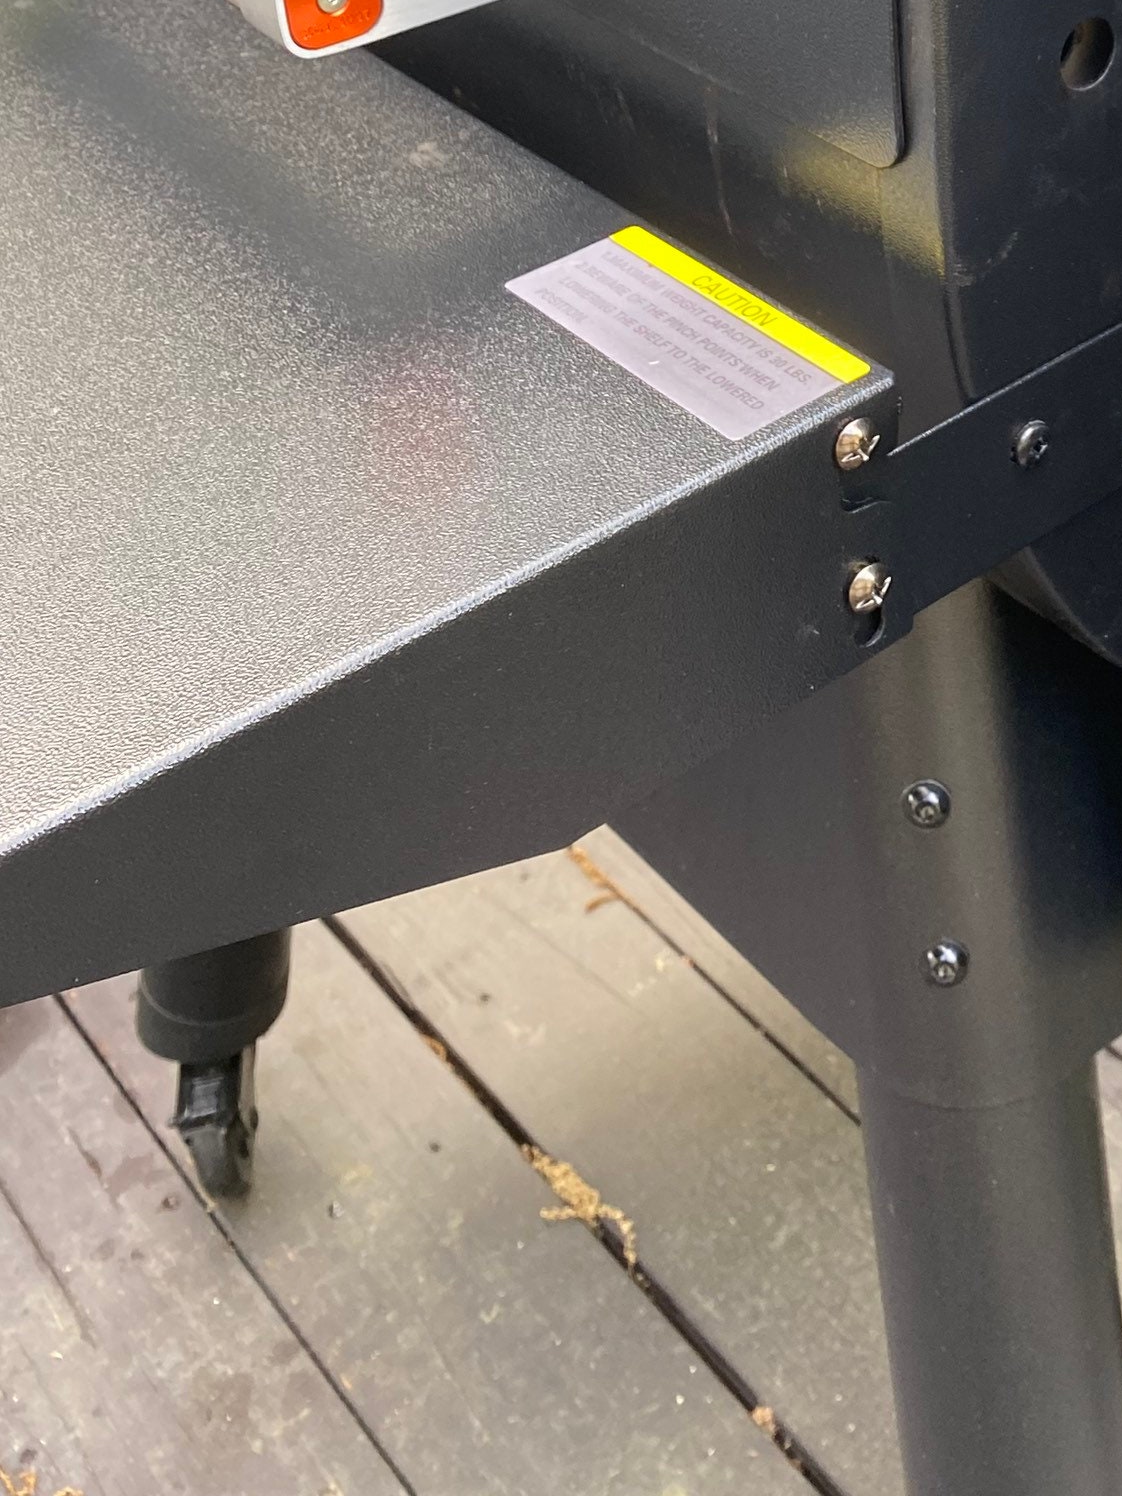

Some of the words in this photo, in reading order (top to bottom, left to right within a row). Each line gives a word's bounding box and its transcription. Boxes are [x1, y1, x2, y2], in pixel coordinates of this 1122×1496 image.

[639, 301, 670, 320] THE
[660, 315, 703, 341] PINCH
[694, 336, 745, 367] POINTS
[735, 362, 783, 391] WHEN
[657, 287, 708, 318] WEIGHT
[698, 313, 763, 351] CAPACITY
[753, 346, 776, 359] IS
[766, 354, 791, 369] 30
[781, 363, 818, 386] LBS.
[687, 273, 780, 328] CAUTION
[609, 310, 640, 328] THE
[630, 323, 674, 350] SHELF
[663, 344, 690, 360] TO
[680, 355, 713, 375] THE
[702, 369, 769, 411] LOWERED
